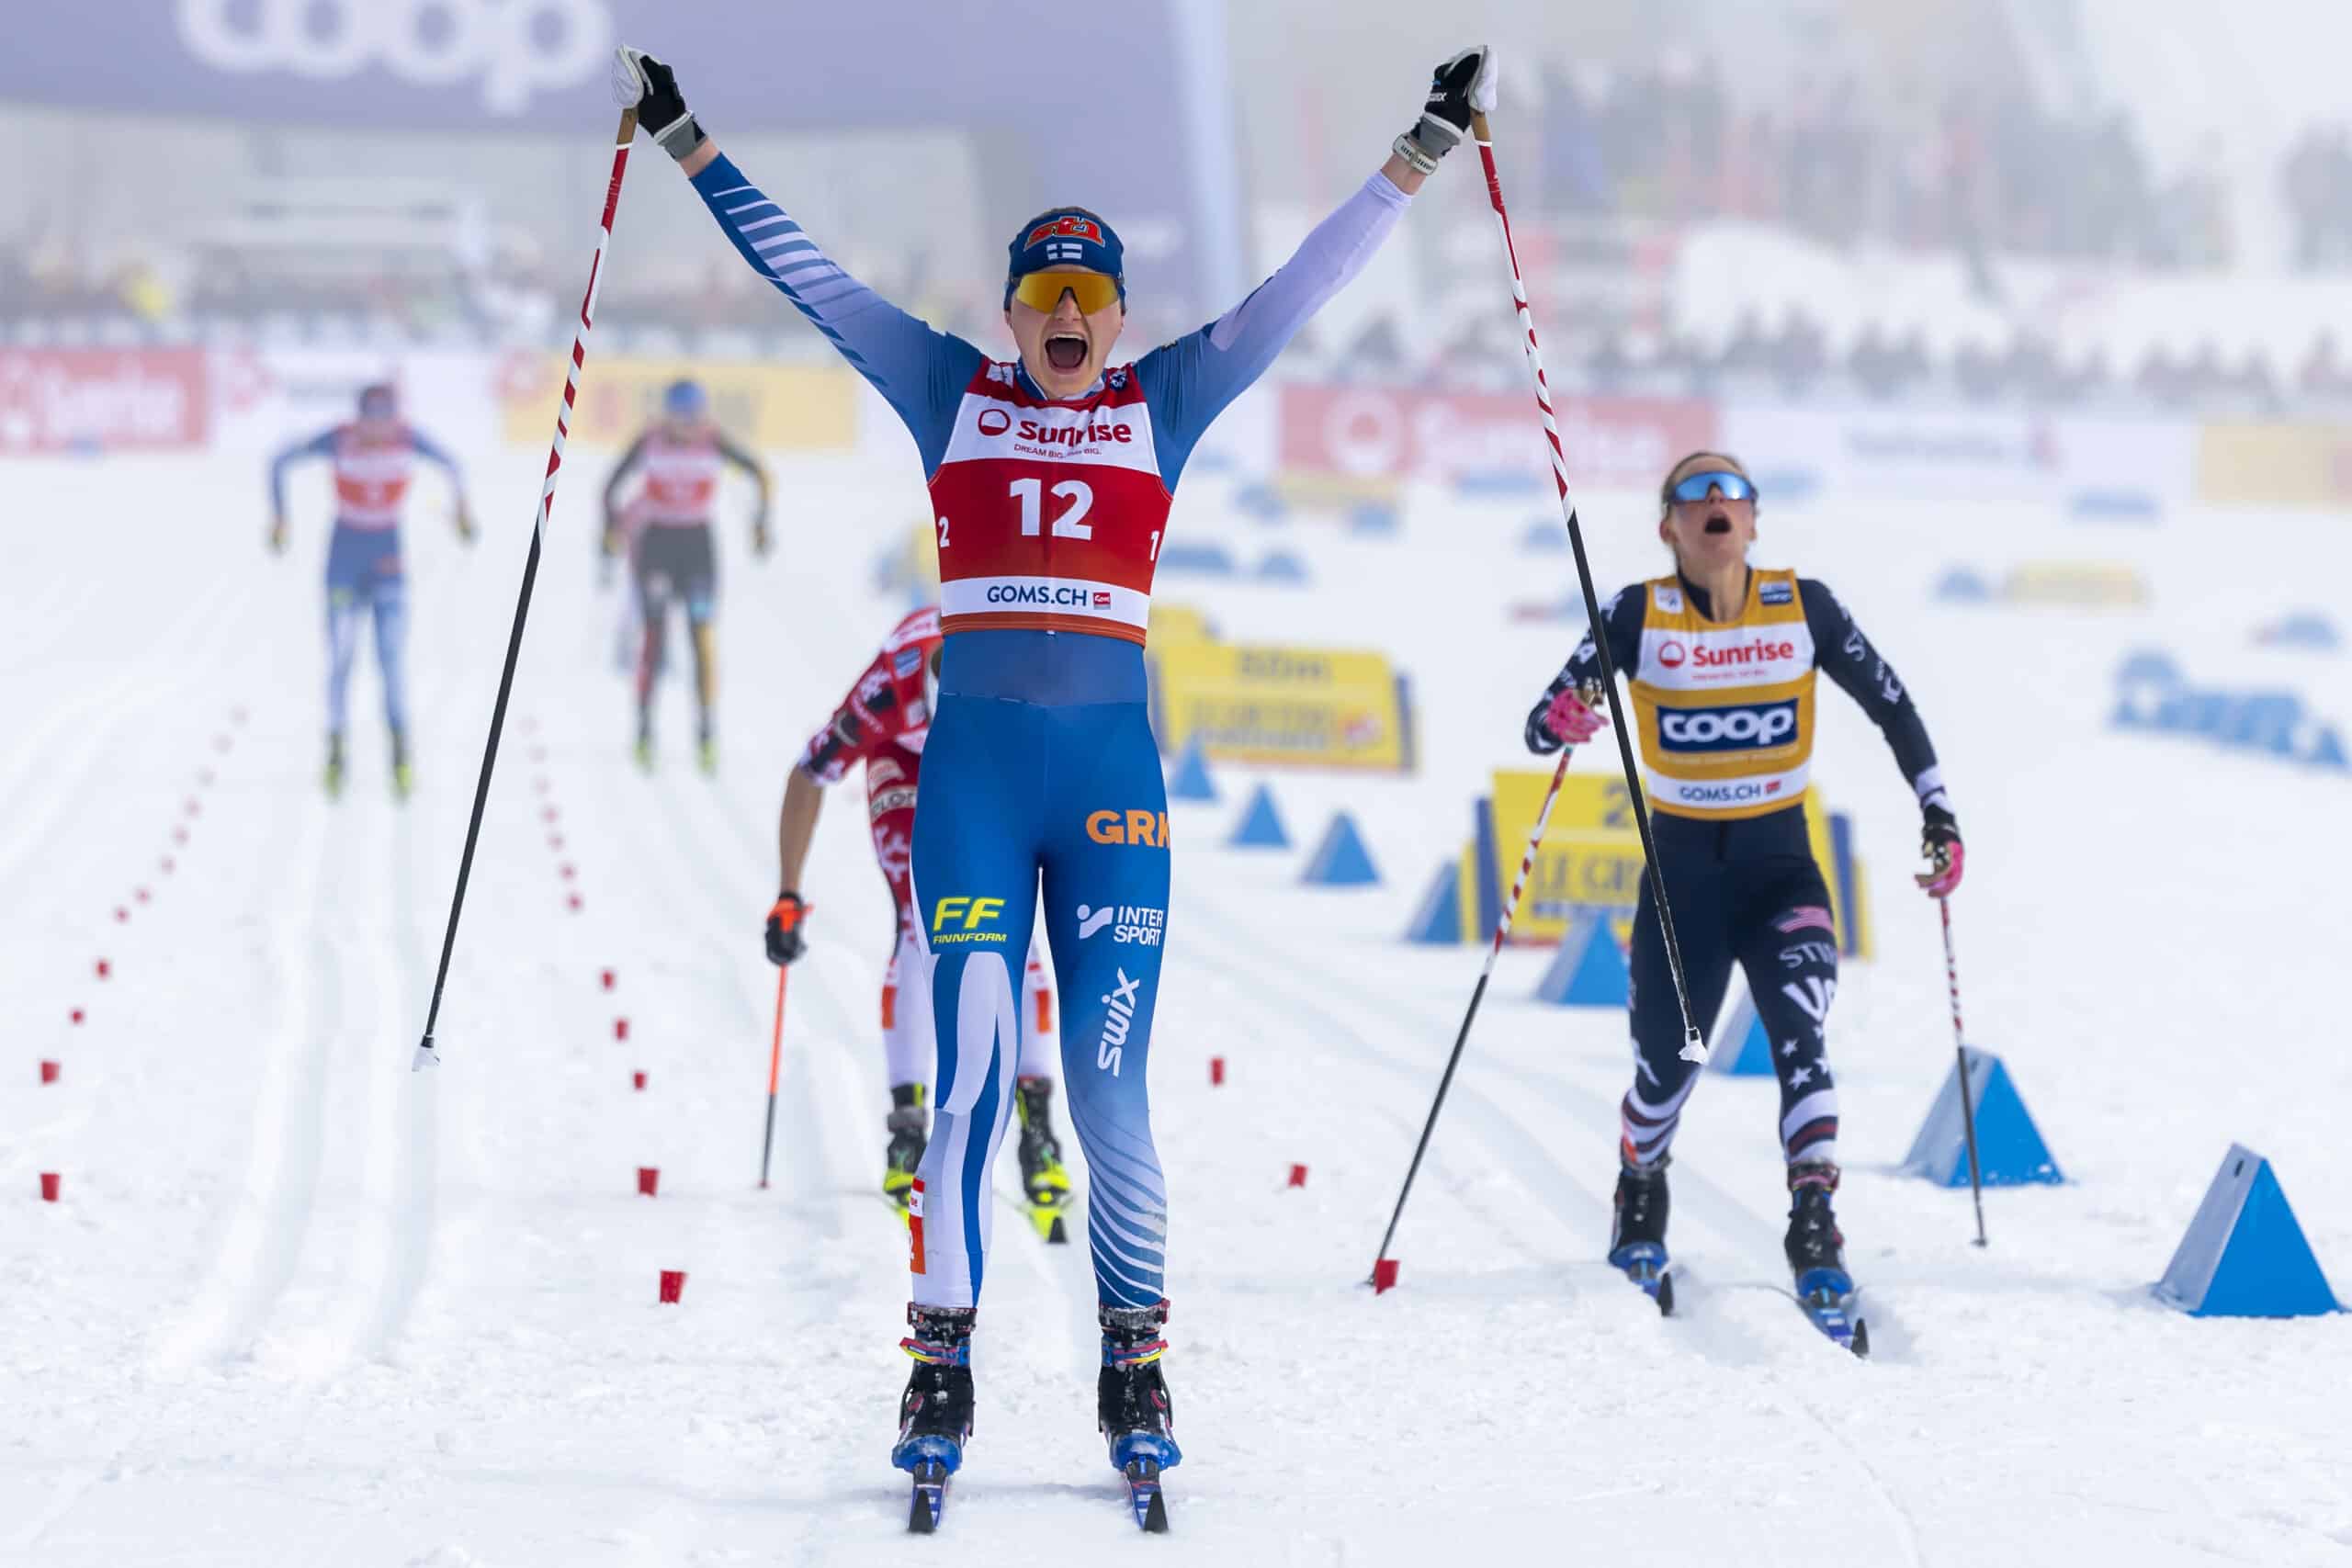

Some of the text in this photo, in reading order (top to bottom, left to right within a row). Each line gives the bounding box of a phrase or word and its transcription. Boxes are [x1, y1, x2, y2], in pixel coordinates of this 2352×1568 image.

[1016, 420, 1132, 446] Sunrise
[1010, 478, 1093, 540] 12
[938, 516, 950, 547] 2
[1150, 530, 1159, 561] 1
[987, 585, 1088, 606] GOMS.CH
[1693, 638, 1794, 667] Sunrise
[1662, 707, 1793, 745] coop
[1679, 784, 1761, 802] GOMS.CH
[933, 897, 1005, 931] FF
[1118, 906, 1163, 928] INTER
[933, 932, 1007, 944] FINNFORM
[1114, 925, 1161, 947] SPORT
